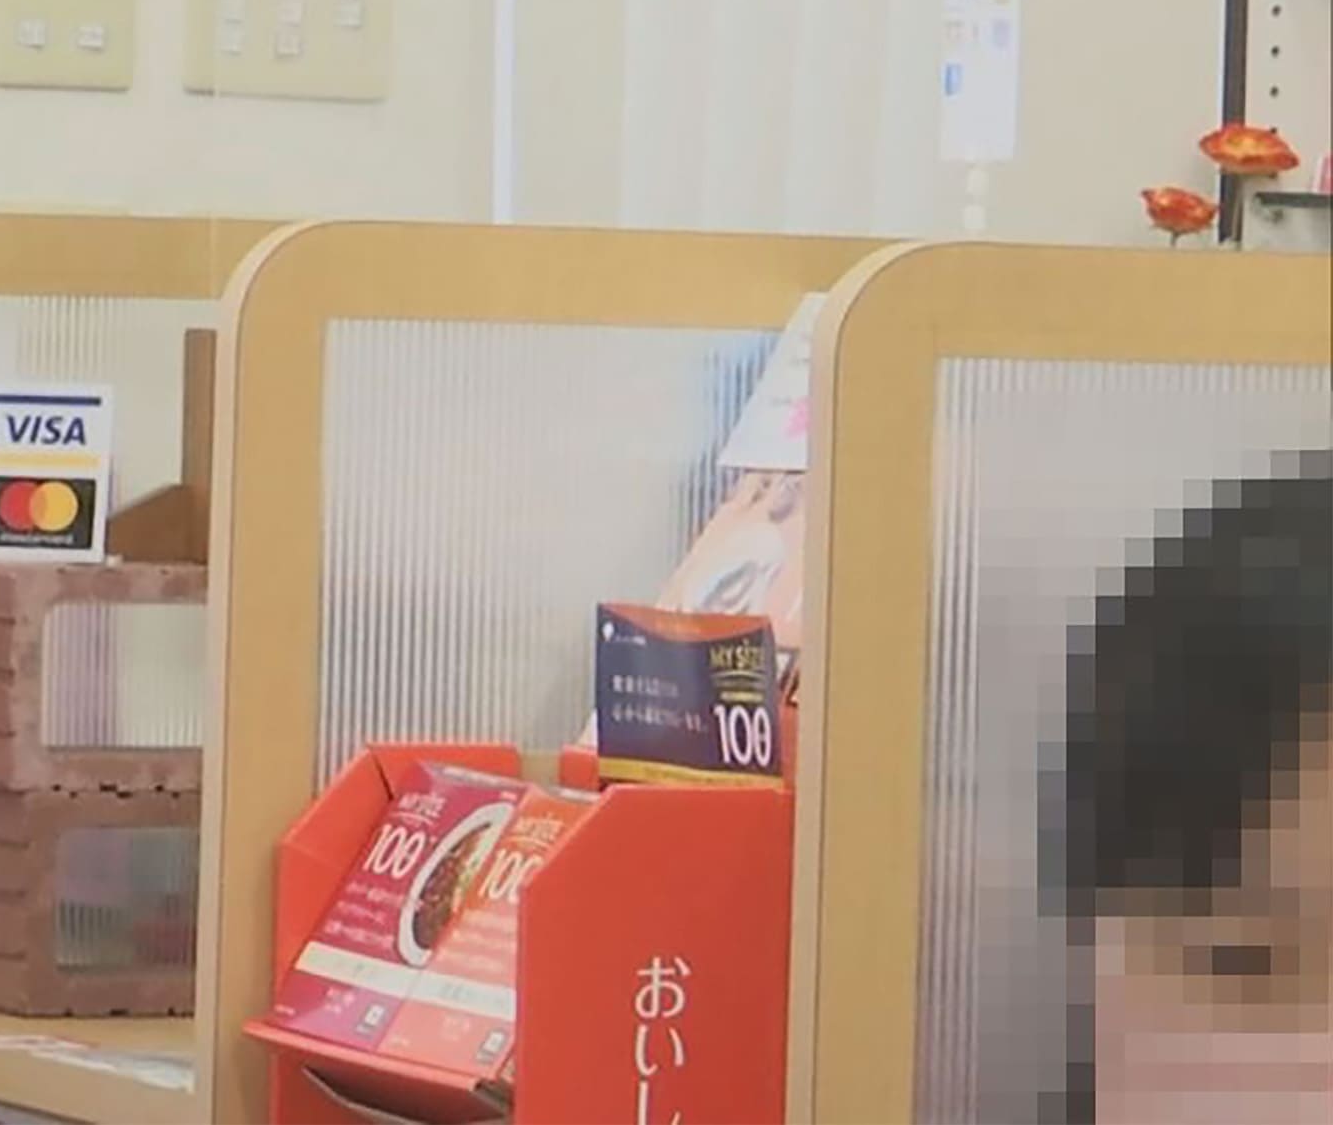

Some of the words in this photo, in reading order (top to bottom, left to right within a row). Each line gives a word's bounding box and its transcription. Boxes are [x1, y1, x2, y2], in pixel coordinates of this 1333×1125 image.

[5, 414, 87, 446] VISA
[713, 704, 772, 768] 100
[363, 824, 426, 880] 100
